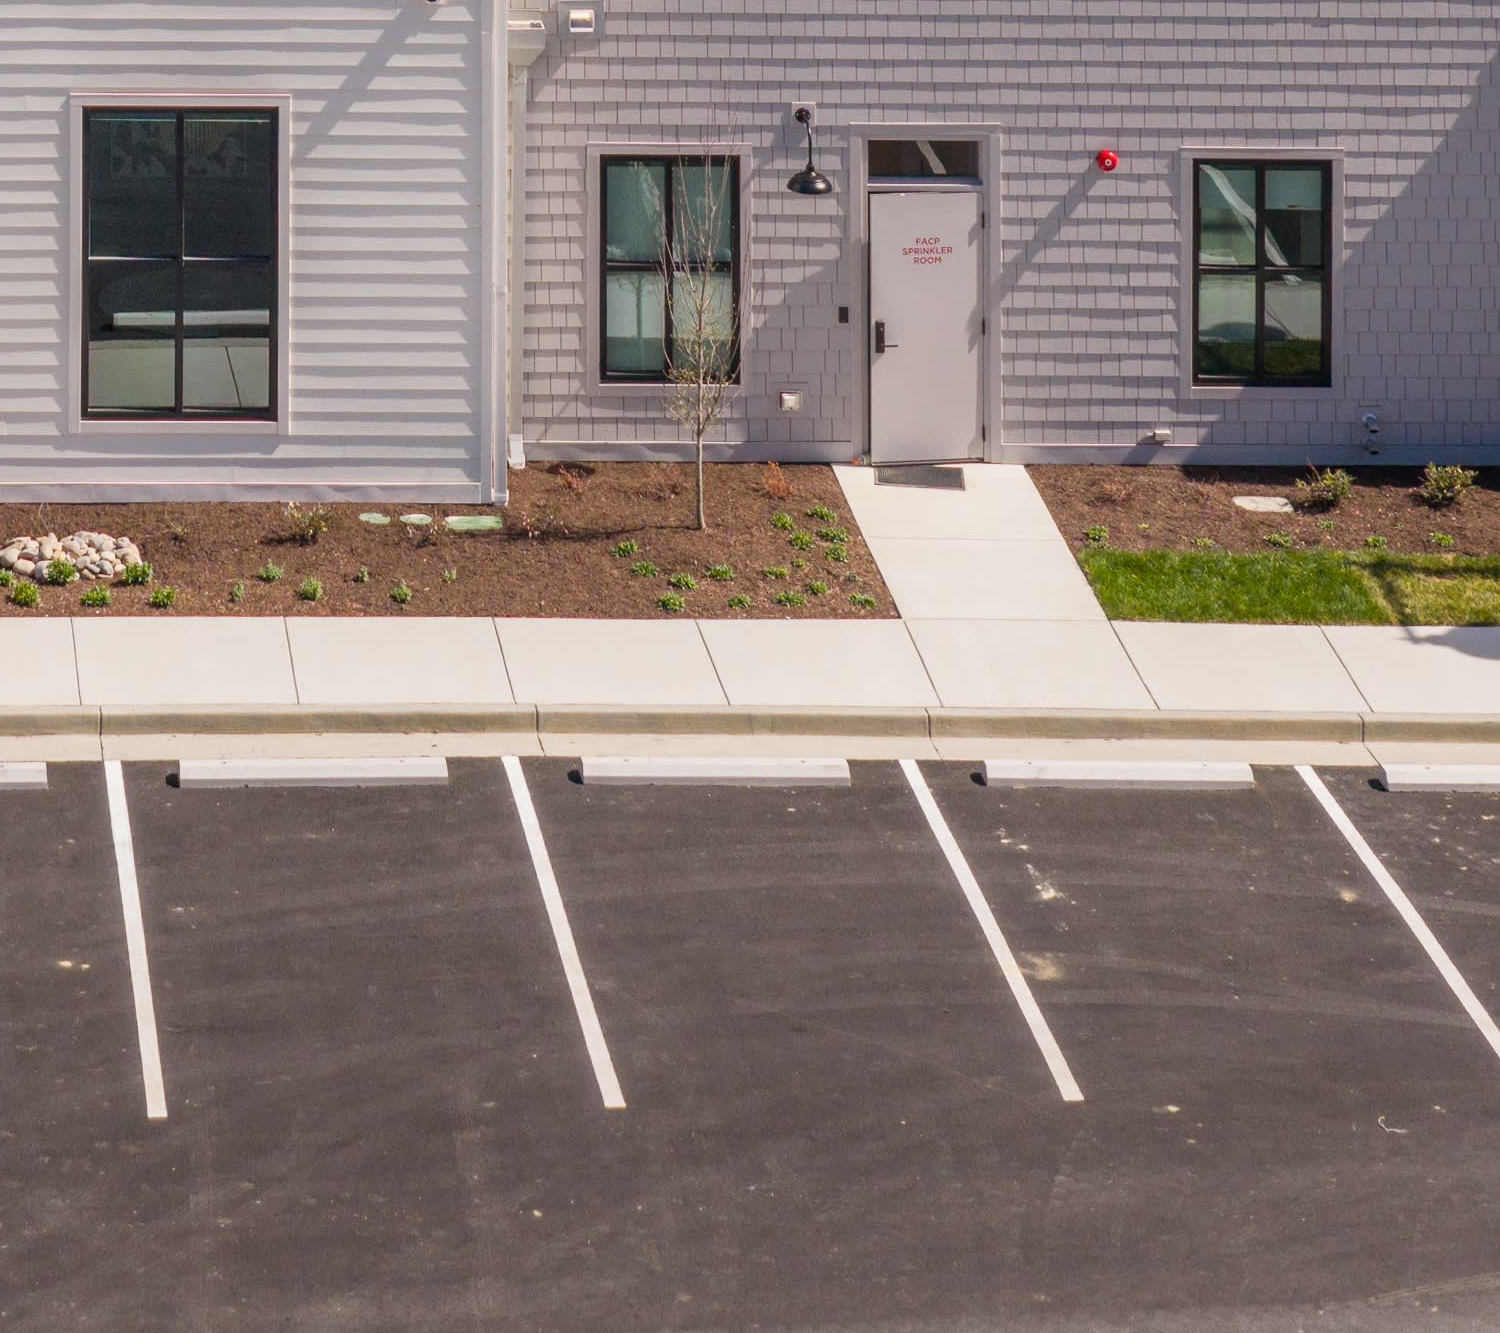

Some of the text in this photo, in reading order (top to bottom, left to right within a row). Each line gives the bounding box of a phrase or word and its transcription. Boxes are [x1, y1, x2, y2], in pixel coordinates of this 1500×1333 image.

[915, 237, 940, 245] FACP
[902, 246, 953, 255] SPRINKLER
[913, 256, 942, 264] ROOM
